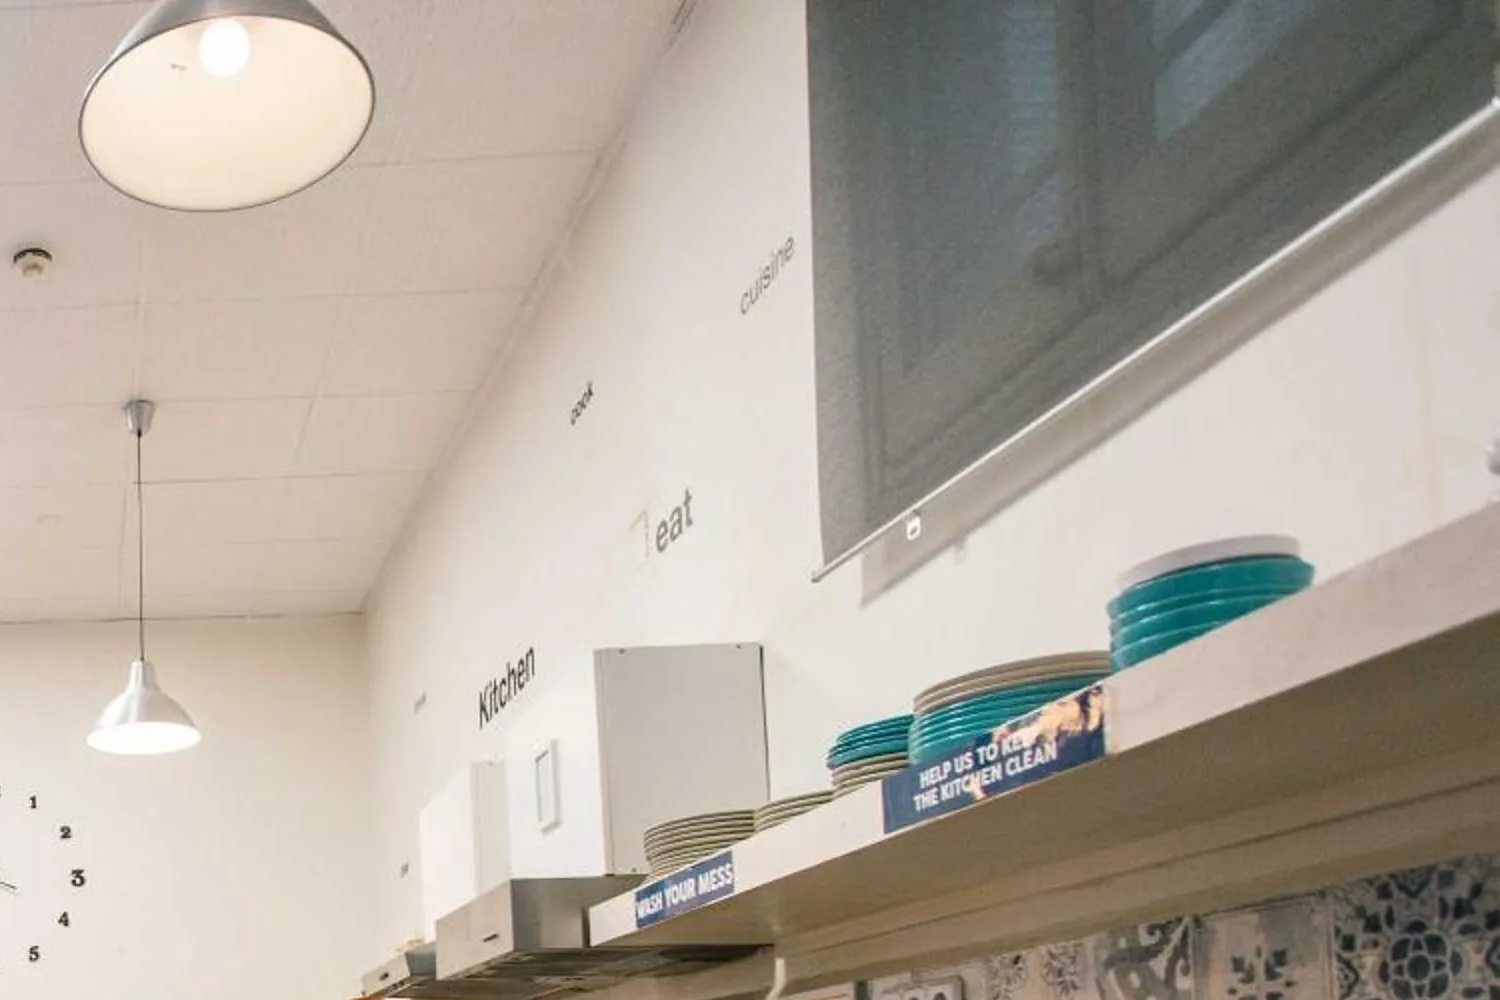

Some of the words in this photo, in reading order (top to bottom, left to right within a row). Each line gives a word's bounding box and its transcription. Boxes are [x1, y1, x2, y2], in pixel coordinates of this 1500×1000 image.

[739, 236, 795, 316] cuisine
[656, 488, 693, 553] eat
[479, 646, 535, 731] Kitchen
[912, 787, 939, 813] THE
[940, 765, 1003, 801] KITCHEN
[1005, 743, 1058, 776] CLEAN
[919, 760, 952, 789] HELP
[954, 752, 973, 773] US
[976, 744, 999, 765] TO
[29, 796, 37, 809] 1
[60, 826, 72, 839] 2
[71, 869, 86, 887] 3
[636, 891, 664, 919] WASH
[664, 878, 697, 908] YOUR
[698, 863, 733, 895] MESS
[57, 912, 70, 927] 4
[28, 945, 40, 962] 5
